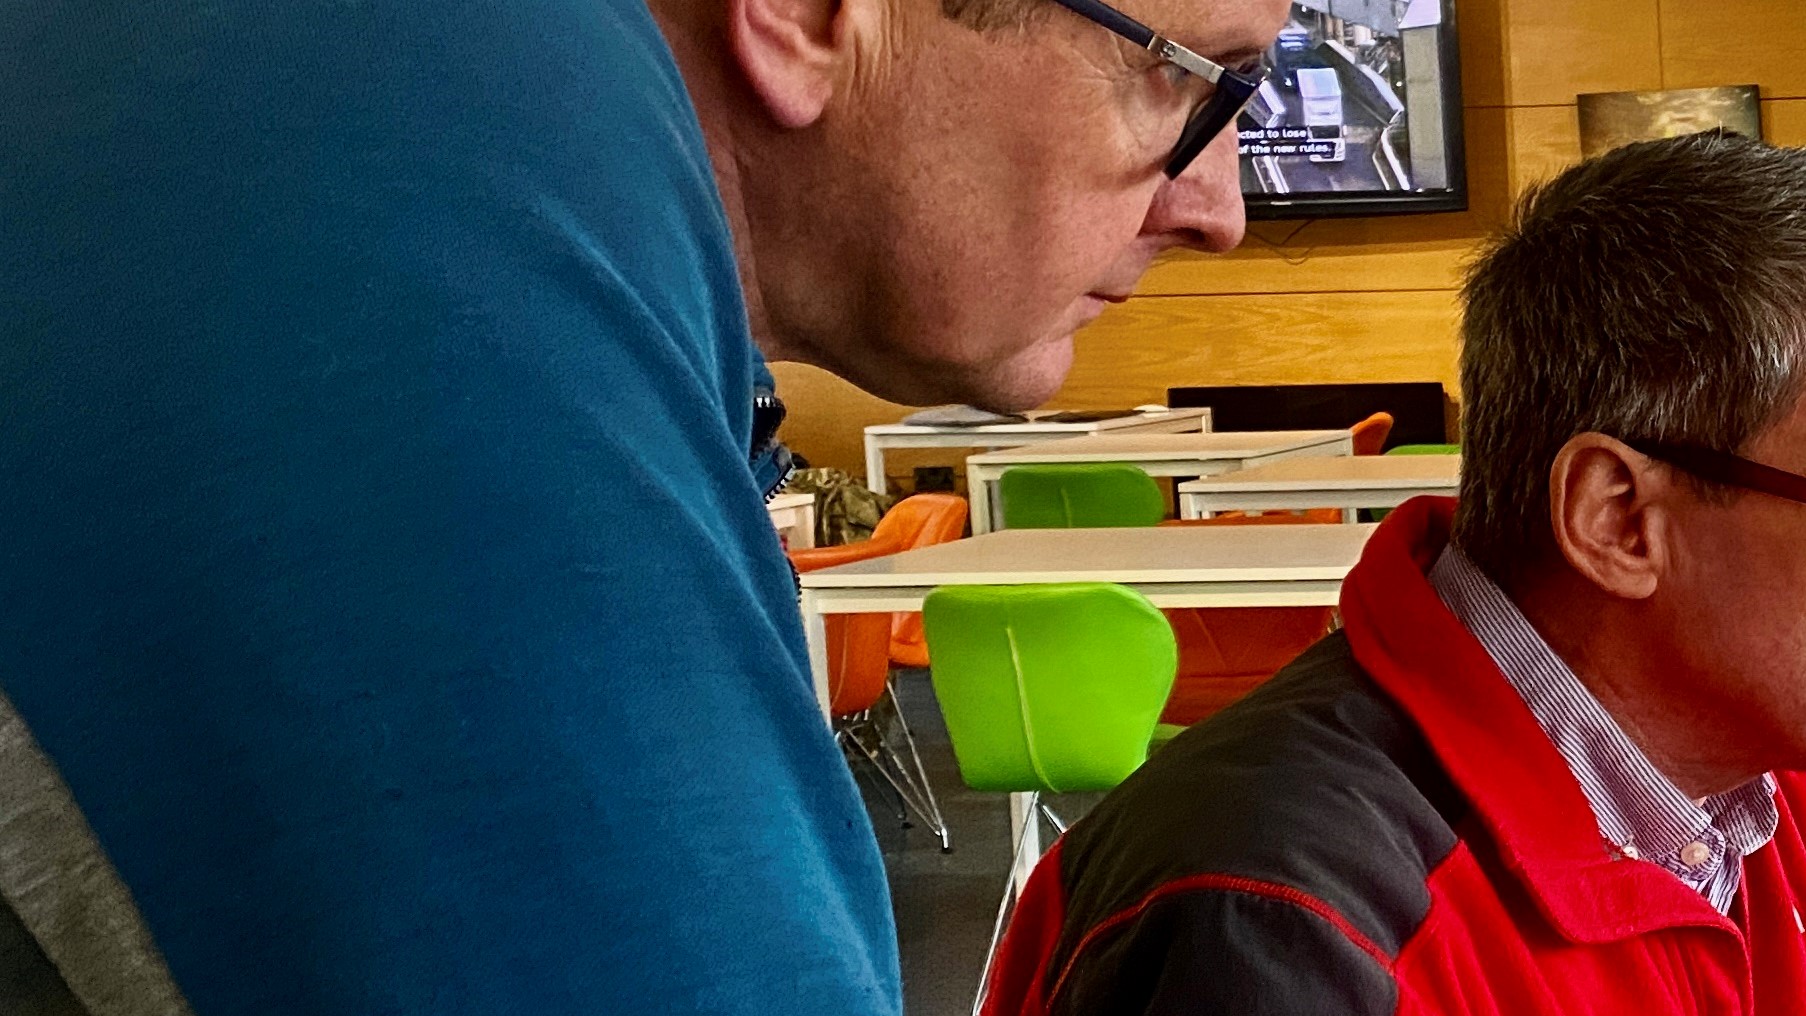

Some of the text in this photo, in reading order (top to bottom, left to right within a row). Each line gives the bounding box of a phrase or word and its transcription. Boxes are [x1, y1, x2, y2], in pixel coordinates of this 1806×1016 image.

[1267, 130, 1279, 138] to
[1282, 129, 1306, 138] lose
[1238, 144, 1249, 154] of
[1251, 144, 1271, 153] the
